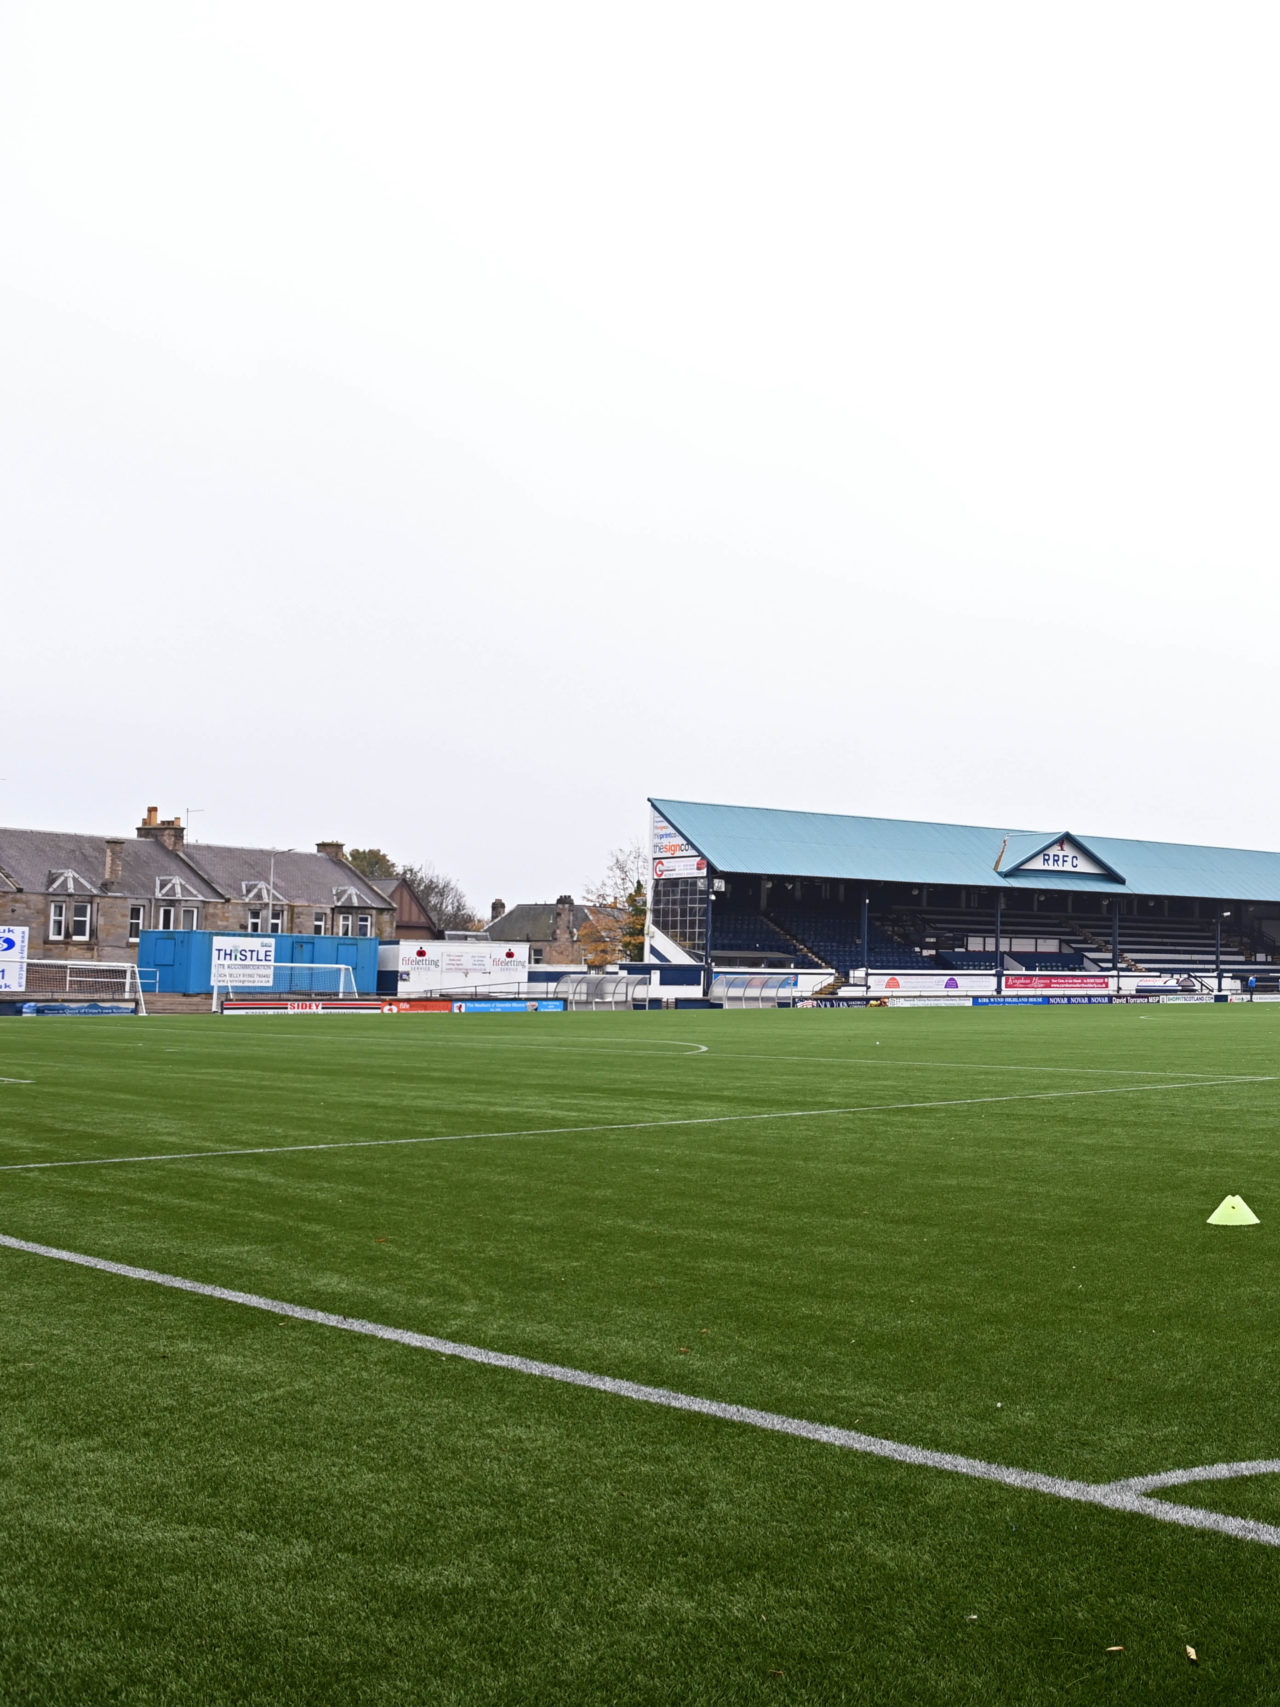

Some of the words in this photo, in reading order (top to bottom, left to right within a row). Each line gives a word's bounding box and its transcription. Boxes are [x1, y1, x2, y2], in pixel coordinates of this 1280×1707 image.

[1042, 853, 1079, 869] RRFC
[1112, 996, 1127, 1004] David
[1128, 996, 1148, 1004] Torrance
[289, 1002, 322, 1010] SIDEY
